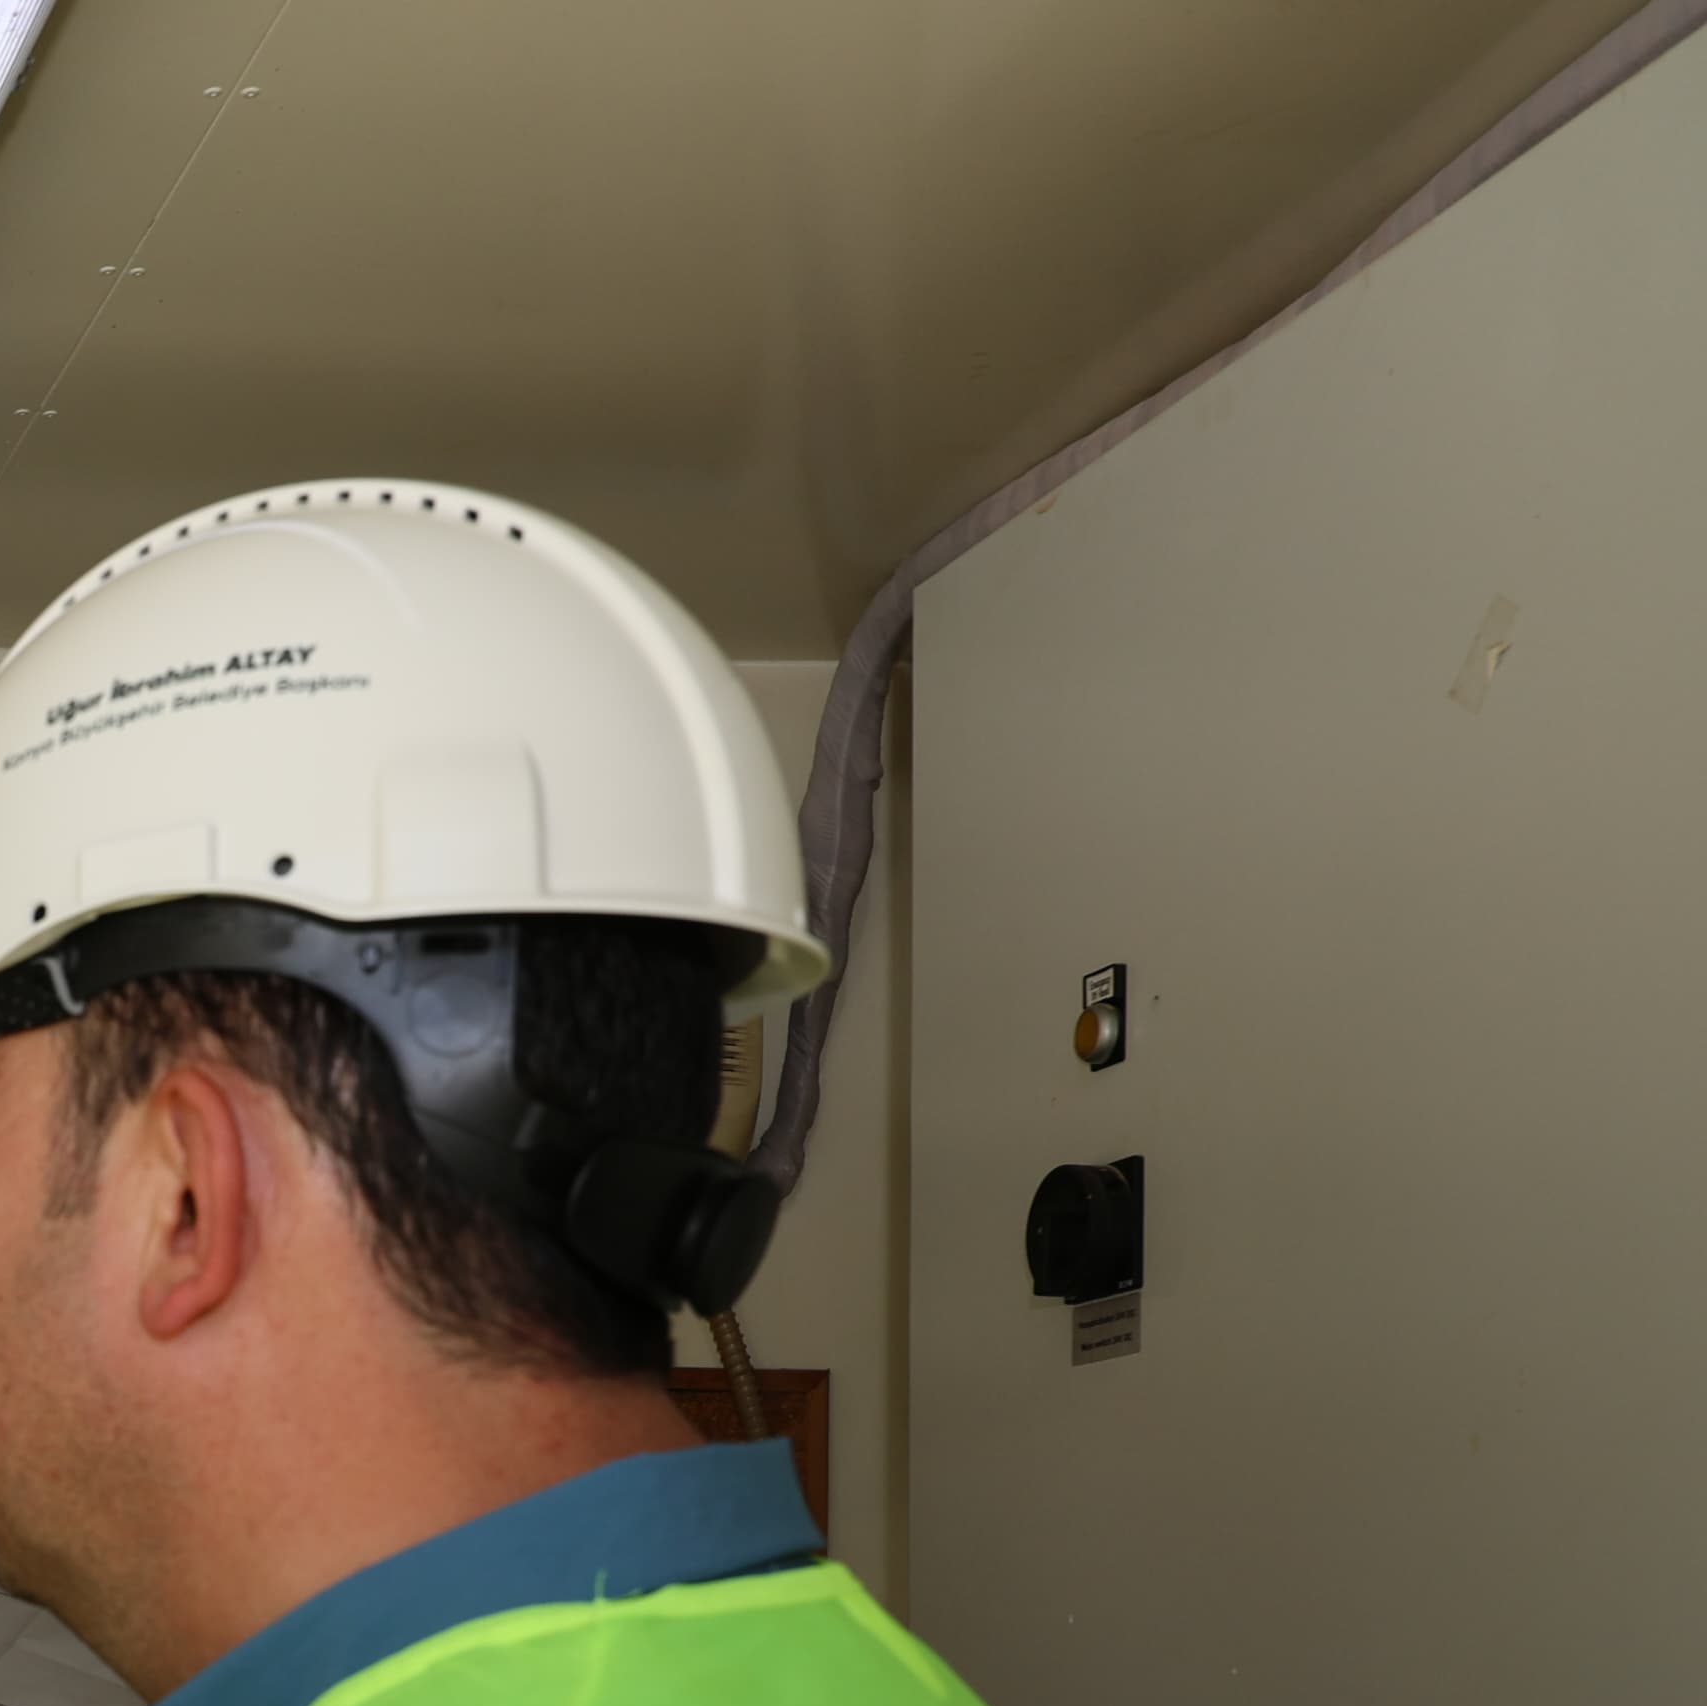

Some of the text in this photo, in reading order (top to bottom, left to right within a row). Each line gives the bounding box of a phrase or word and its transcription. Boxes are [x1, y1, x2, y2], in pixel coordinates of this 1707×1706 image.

[45, 644, 318, 726] Uğur İbrahim ALTAY
